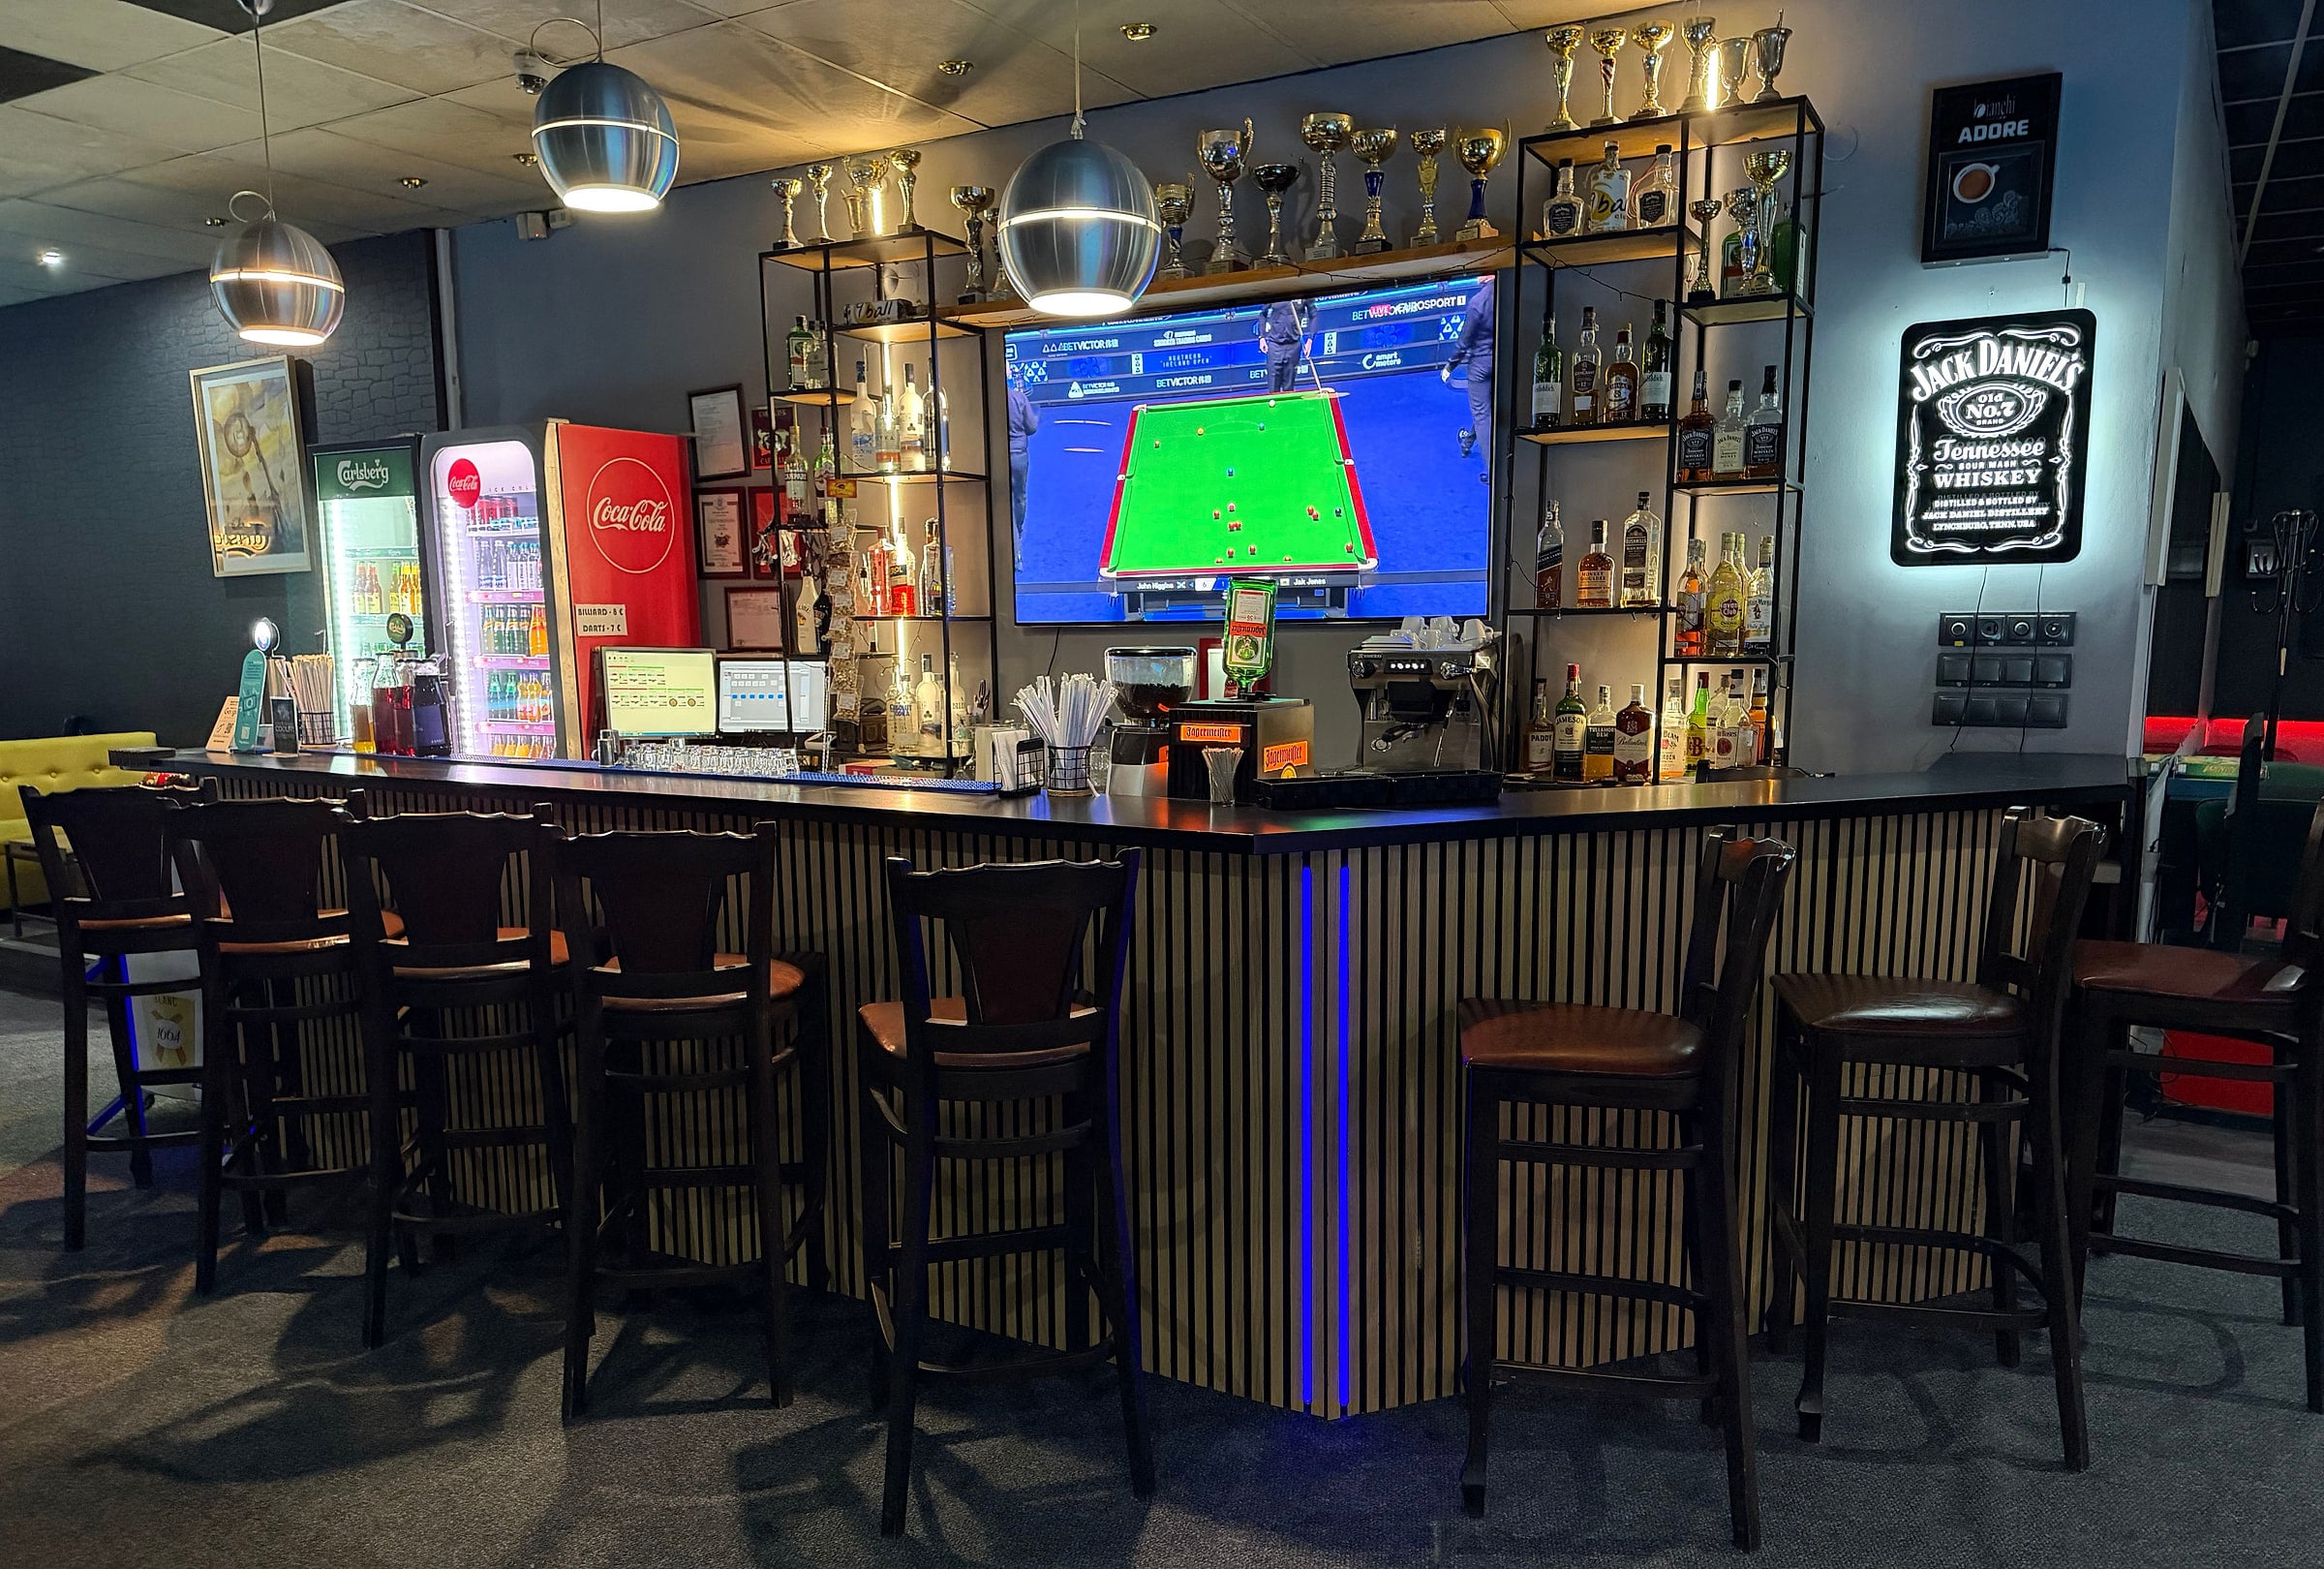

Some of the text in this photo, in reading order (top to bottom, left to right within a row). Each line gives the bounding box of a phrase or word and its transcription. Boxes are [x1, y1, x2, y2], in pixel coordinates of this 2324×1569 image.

[1958, 119, 2030, 143] ADORE
[1063, 340, 1105, 352] BETVICTOR
[1911, 339, 2083, 401] JACK DANIEL'S
[1156, 375, 1199, 387] BETVICTOR
[1978, 392, 2003, 403] Old
[1966, 401, 2015, 418] No.7
[1933, 439, 2044, 462] Tennessee
[1958, 459, 2017, 470] SOUR MASH
[338, 459, 388, 491] Carlsberg
[448, 475, 479, 492] Coca-Cola
[1933, 469, 2042, 488] WHISKEY
[1935, 499, 1977, 508] DISTILLED
[1986, 496, 2024, 506] BOTTLED
[2025, 496, 2037, 505] BY
[593, 497, 668, 532] Coca-Cola
[1948, 510, 1986, 519] DANIEL
[1987, 507, 2049, 518] DISTILLERY
[157, 1028, 181, 1043] 1664
